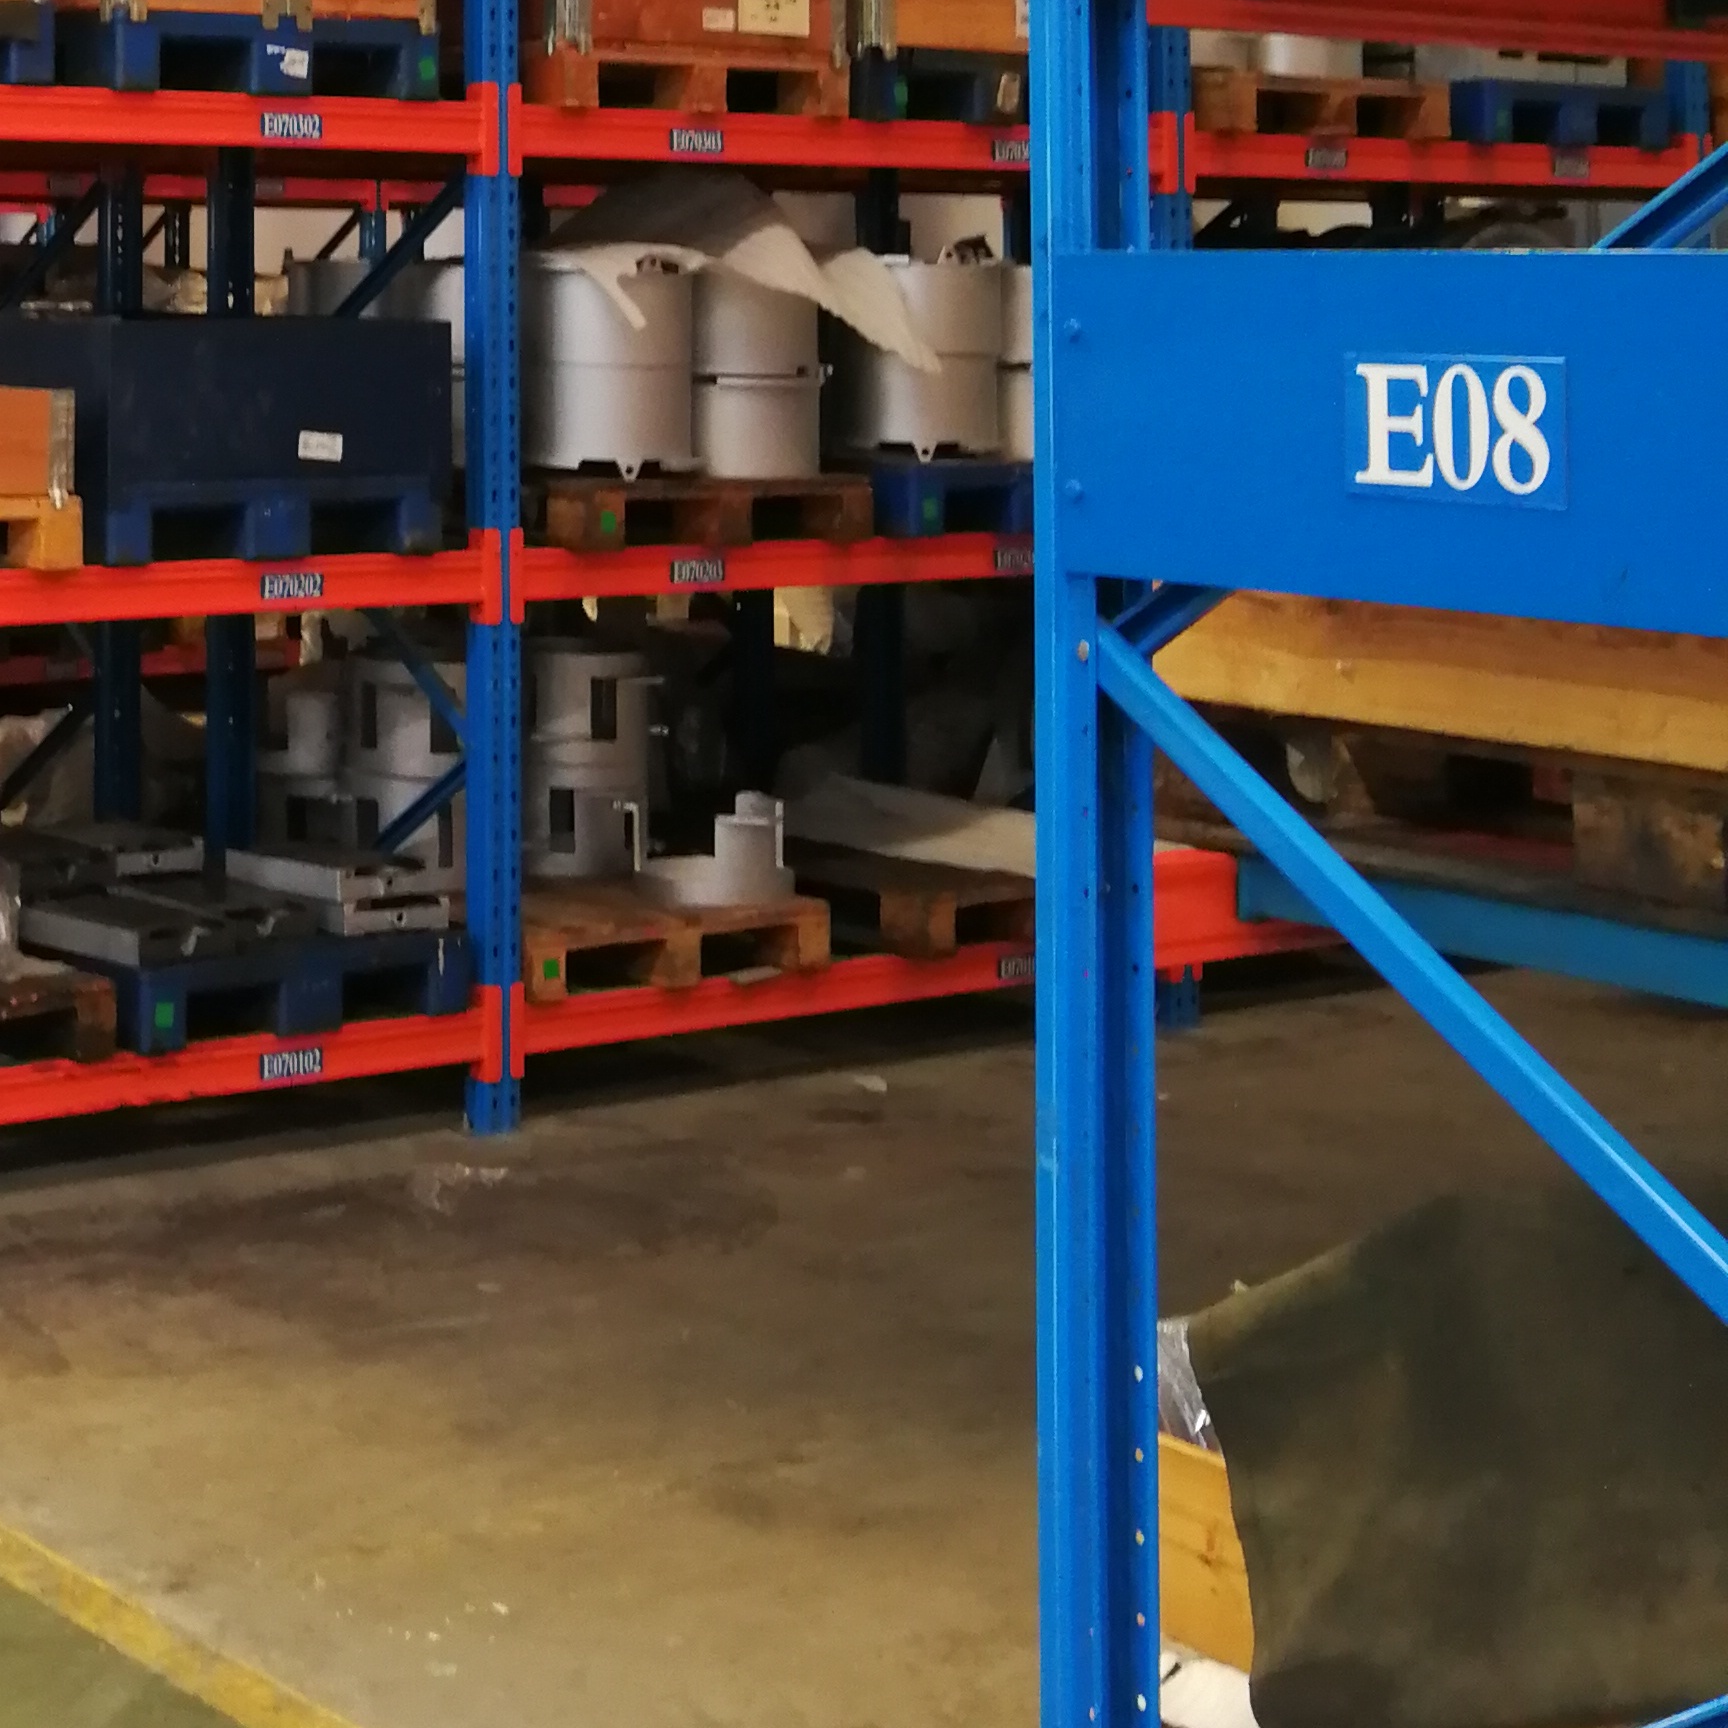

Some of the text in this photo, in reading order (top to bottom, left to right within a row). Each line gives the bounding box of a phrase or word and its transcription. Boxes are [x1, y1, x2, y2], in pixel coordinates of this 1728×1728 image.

[262, 113, 321, 139] E070302
[1354, 362, 1551, 496] E08
[262, 574, 323, 600] E070202
[261, 1048, 321, 1081] E070102
